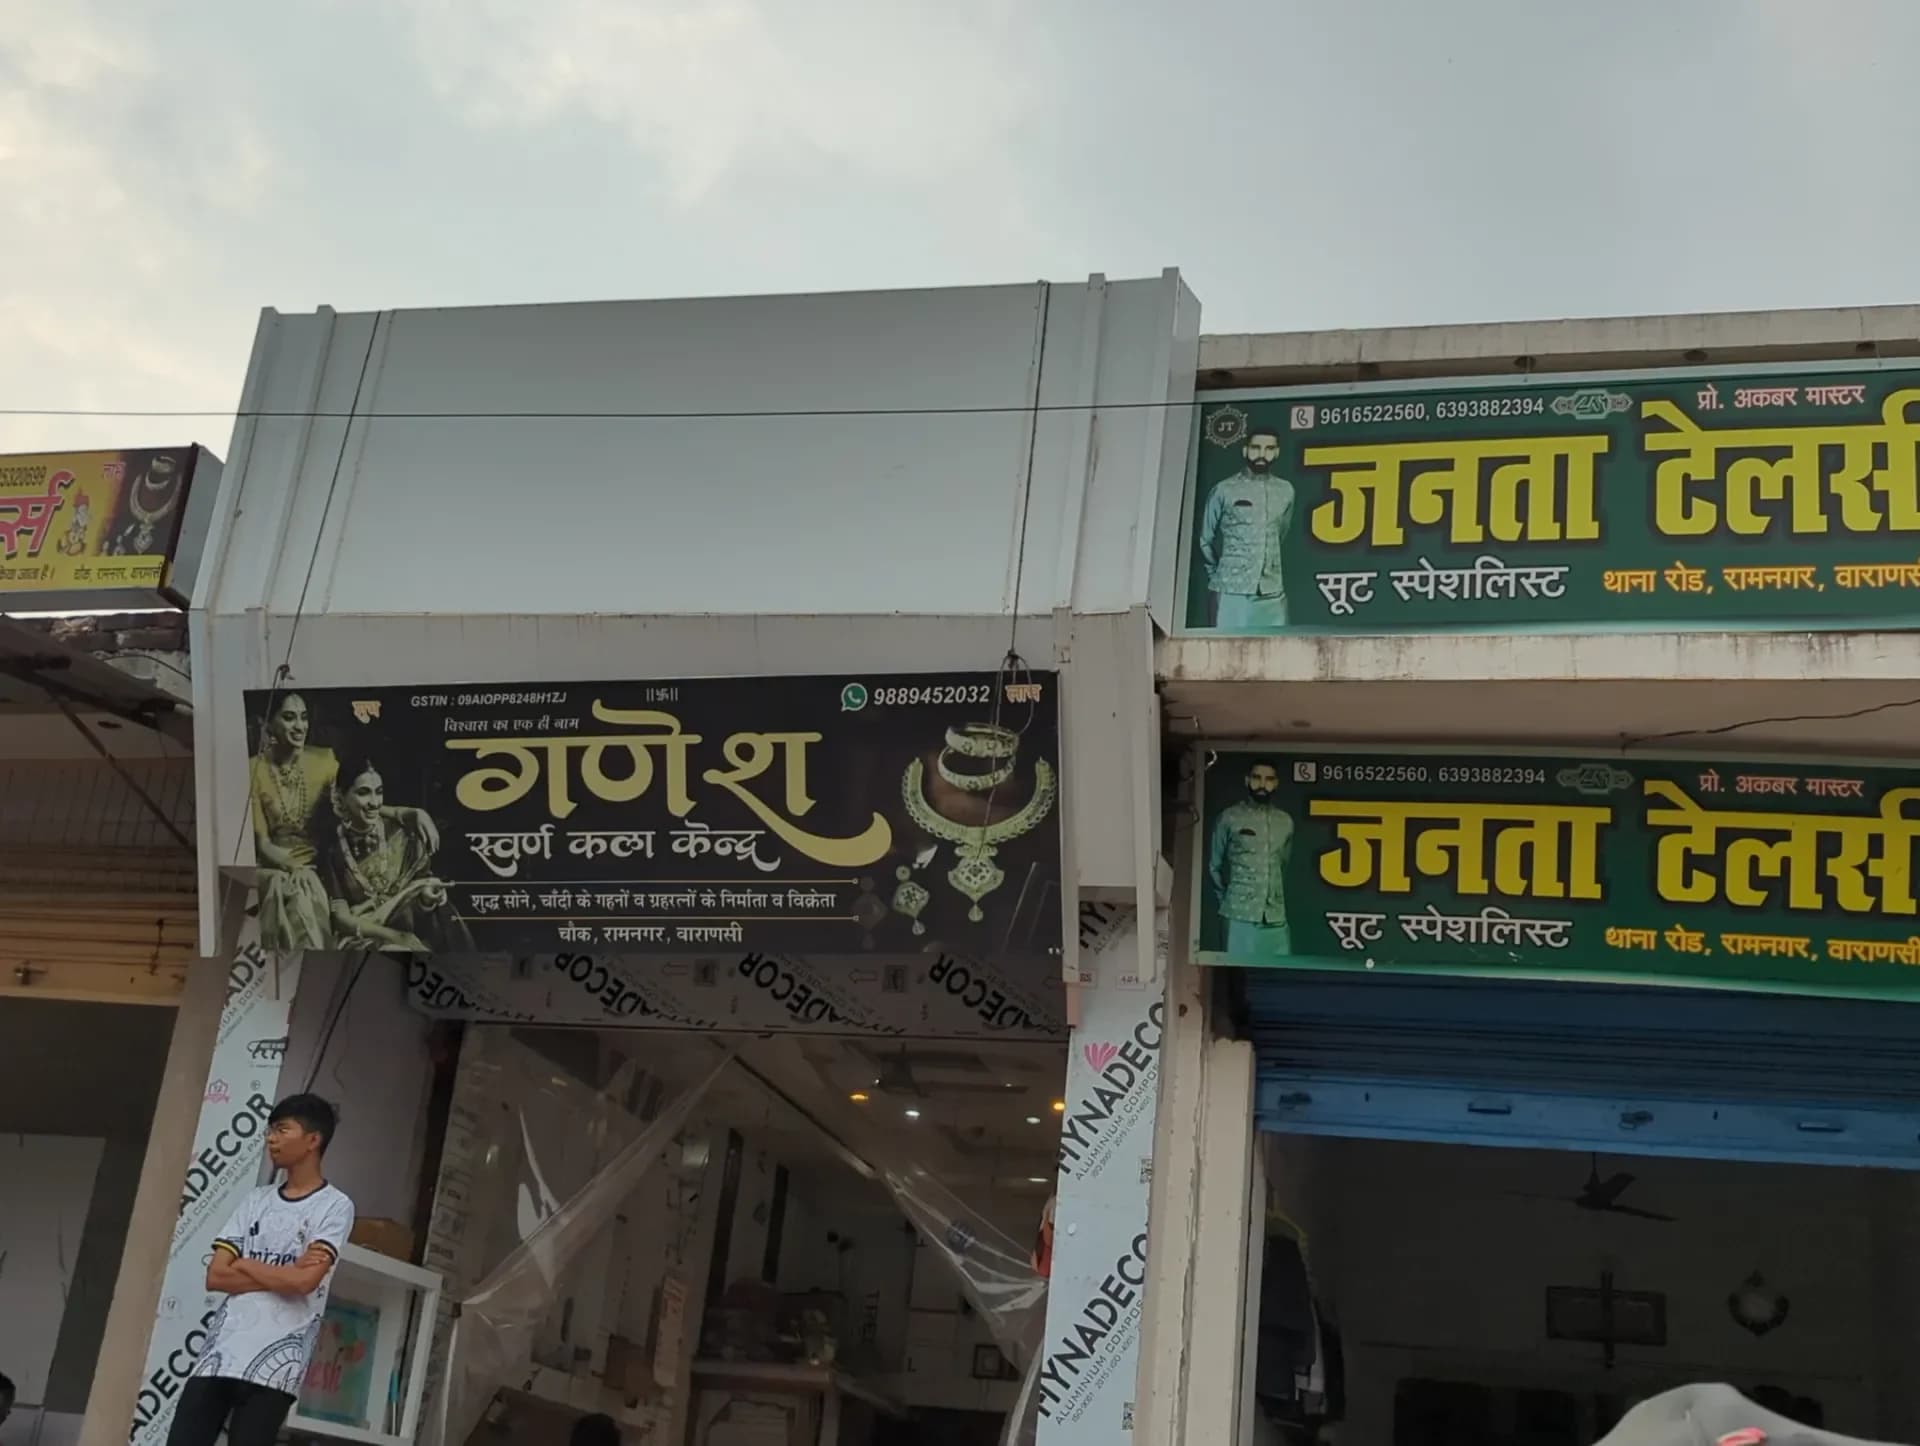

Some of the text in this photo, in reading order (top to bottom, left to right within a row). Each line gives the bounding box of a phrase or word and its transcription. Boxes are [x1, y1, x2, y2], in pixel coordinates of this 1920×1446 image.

[1320, 402, 1430, 424] 9616522560,
[1436, 398, 1544, 419] 6393882394
[1697, 384, 1866, 410] प्रो. अकबर मास्टर
[1304, 435, 1608, 547] जनता
[1316, 554, 1570, 616] सूट स्पेशलिस्ट
[1603, 557, 1920, 595] थाना रोड, रामनगर, वाराणस
[410, 695, 448, 707] GSTIN
[874, 686, 990, 706] 9889452032
[444, 714, 580, 733] विश्वास का एक ही नाम
[445, 698, 892, 868] गणेश
[1323, 764, 1432, 784] 9616522560,
[1438, 766, 1546, 785] 6393882394
[1700, 768, 1864, 797] प्रो. अकबर मास्टर
[465, 818, 782, 878] स्वर्ण कला केन्द्र
[1310, 799, 1611, 900] जनता
[471, 893, 500, 914] शुद्ध
[575, 889, 591, 909] के
[594, 889, 630, 911] गहनों
[633, 893, 645, 908] व
[700, 889, 717, 909] के
[720, 889, 768, 909] निर्माता
[771, 893, 784, 909] व
[787, 889, 837, 909] विक्रेता
[602, 926, 671, 945] रामनगर,
[676, 921, 743, 943] वाराणसी
[1326, 904, 1573, 950] सूट स्पेशलिस्ट
[1605, 926, 1657, 950] थाना
[1664, 923, 1712, 956] रोड,
[1720, 933, 1819, 962] रामनगर,
[1056, 997, 1166, 1176] HYNADECO
[180, 1091, 274, 1213] ADECOR
[1037, 1225, 1147, 1419] HYNADECO
